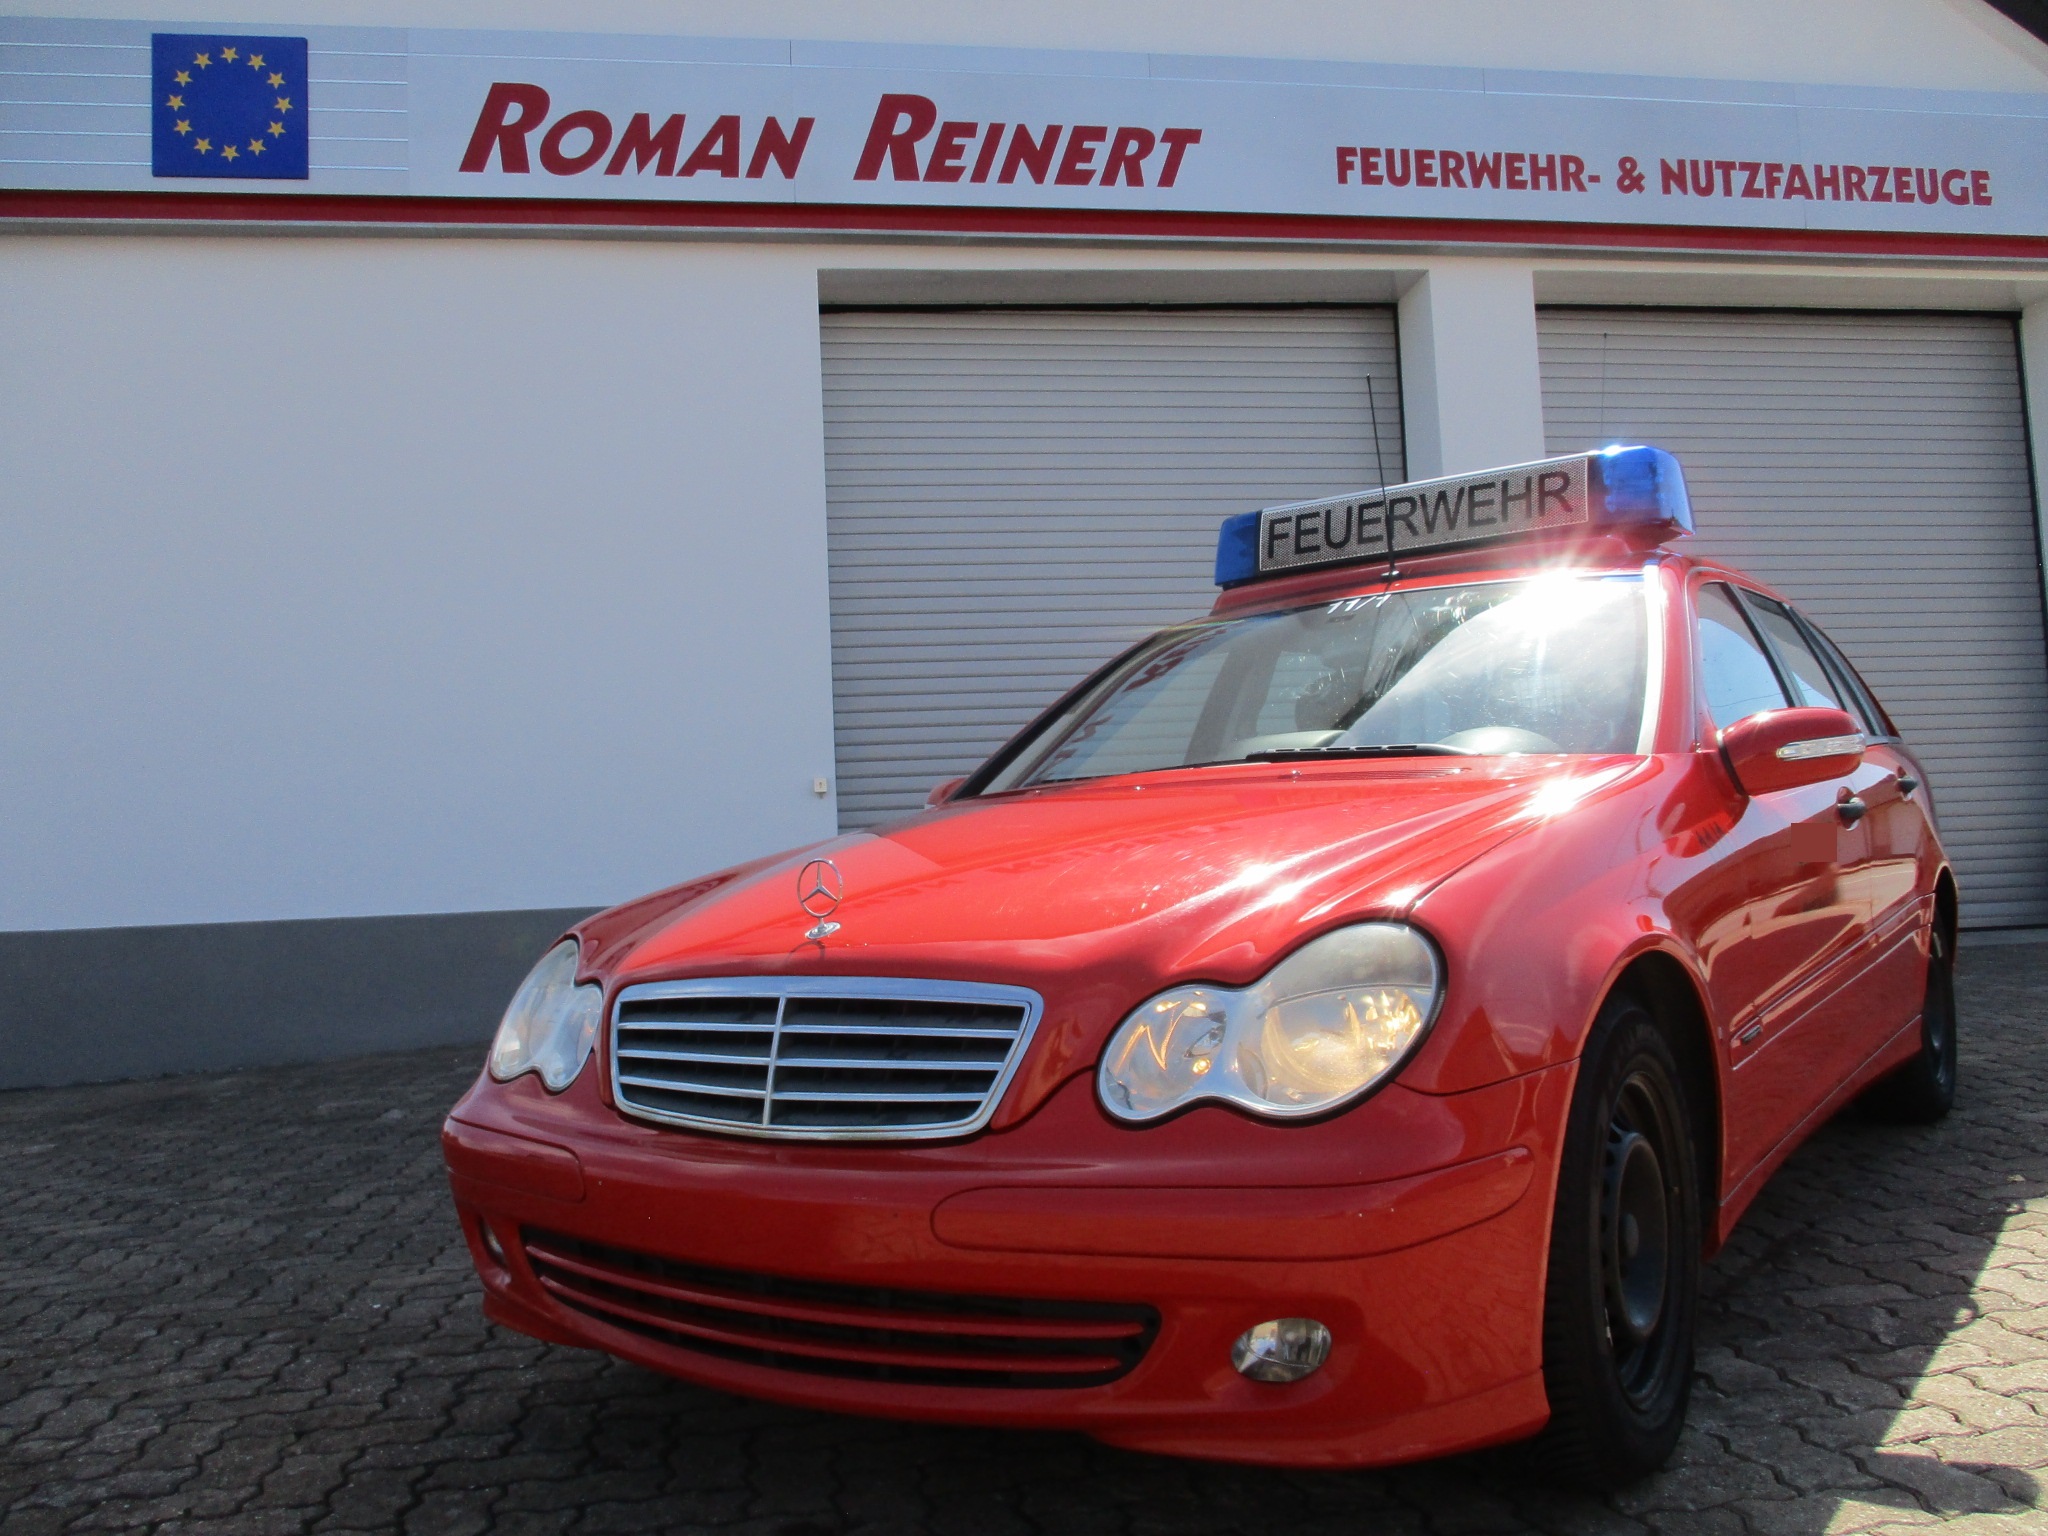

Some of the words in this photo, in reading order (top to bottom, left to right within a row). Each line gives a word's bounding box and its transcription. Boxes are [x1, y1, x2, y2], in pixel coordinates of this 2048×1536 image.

[459, 82, 815, 180] ROMAN
[853, 93, 1203, 188] REINERT
[1336, 146, 1601, 193] FEUERWEHR-
[1616, 156, 1646, 195] &
[1660, 158, 1993, 206] NUTZFAHRZEUGE
[1268, 470, 1573, 559] FEUERWEHR
[1327, 594, 1392, 615] 11/1
